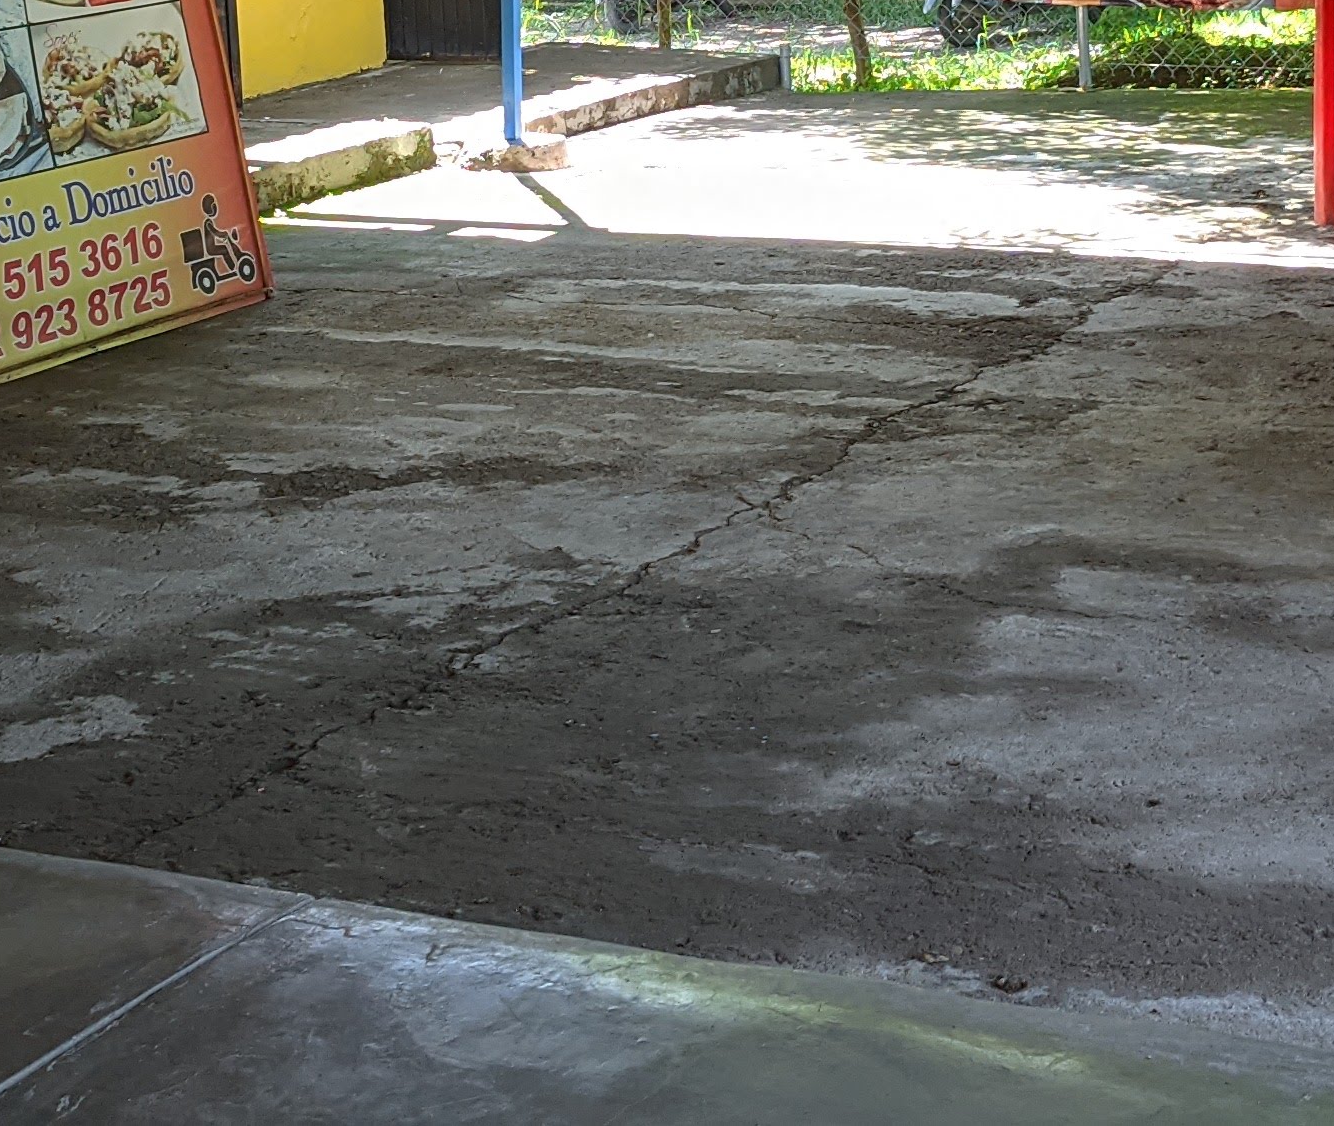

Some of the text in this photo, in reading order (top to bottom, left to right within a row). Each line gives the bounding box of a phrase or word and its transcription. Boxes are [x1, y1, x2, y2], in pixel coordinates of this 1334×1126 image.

[42, 204, 62, 232] a
[62, 156, 195, 226] Domicilio
[3, 247, 71, 300] 515
[79, 222, 164, 279] 3616
[11, 297, 79, 350] 923
[88, 269, 172, 327] 8725
